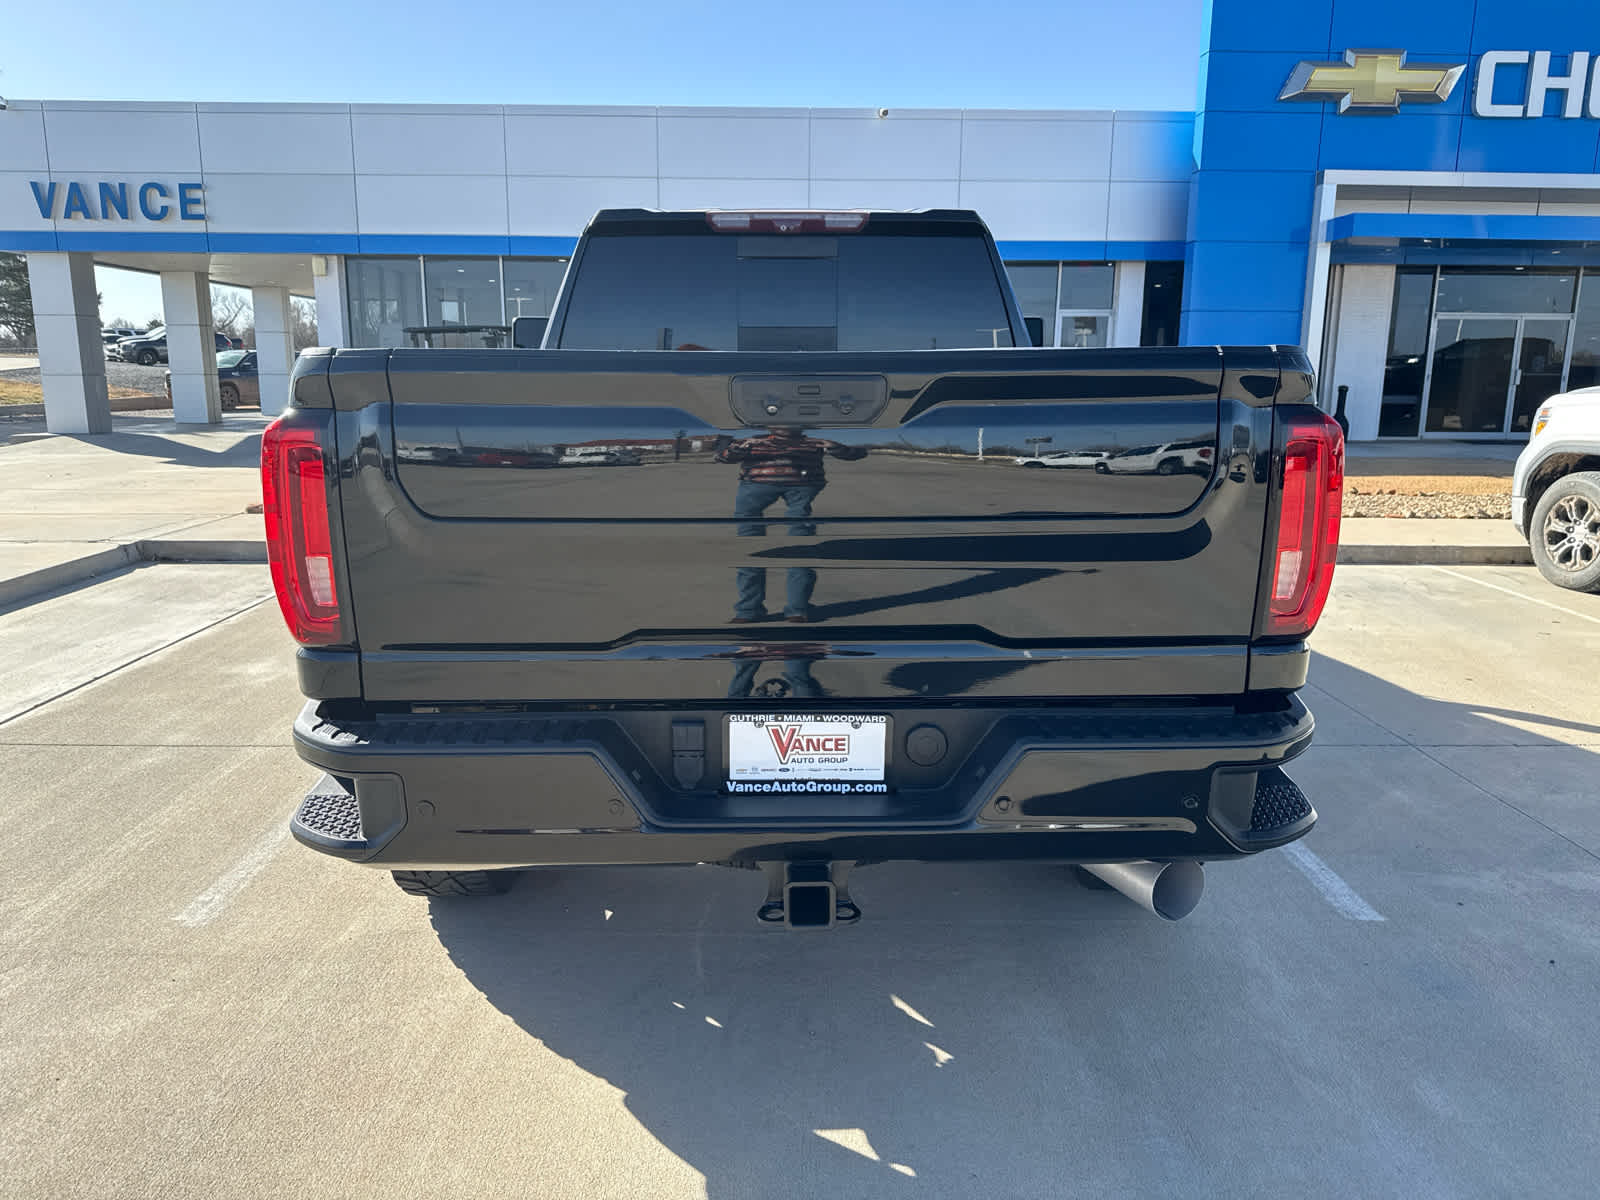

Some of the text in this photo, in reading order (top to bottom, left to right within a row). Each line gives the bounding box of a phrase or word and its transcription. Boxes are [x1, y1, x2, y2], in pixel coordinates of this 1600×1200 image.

[1475, 50, 1600, 118] CH
[30, 181, 206, 221] VANCE
[784, 714, 815, 722] MIAMI
[823, 715, 886, 723] WOODWARD
[726, 781, 887, 794] VanceAutoGroup.com
